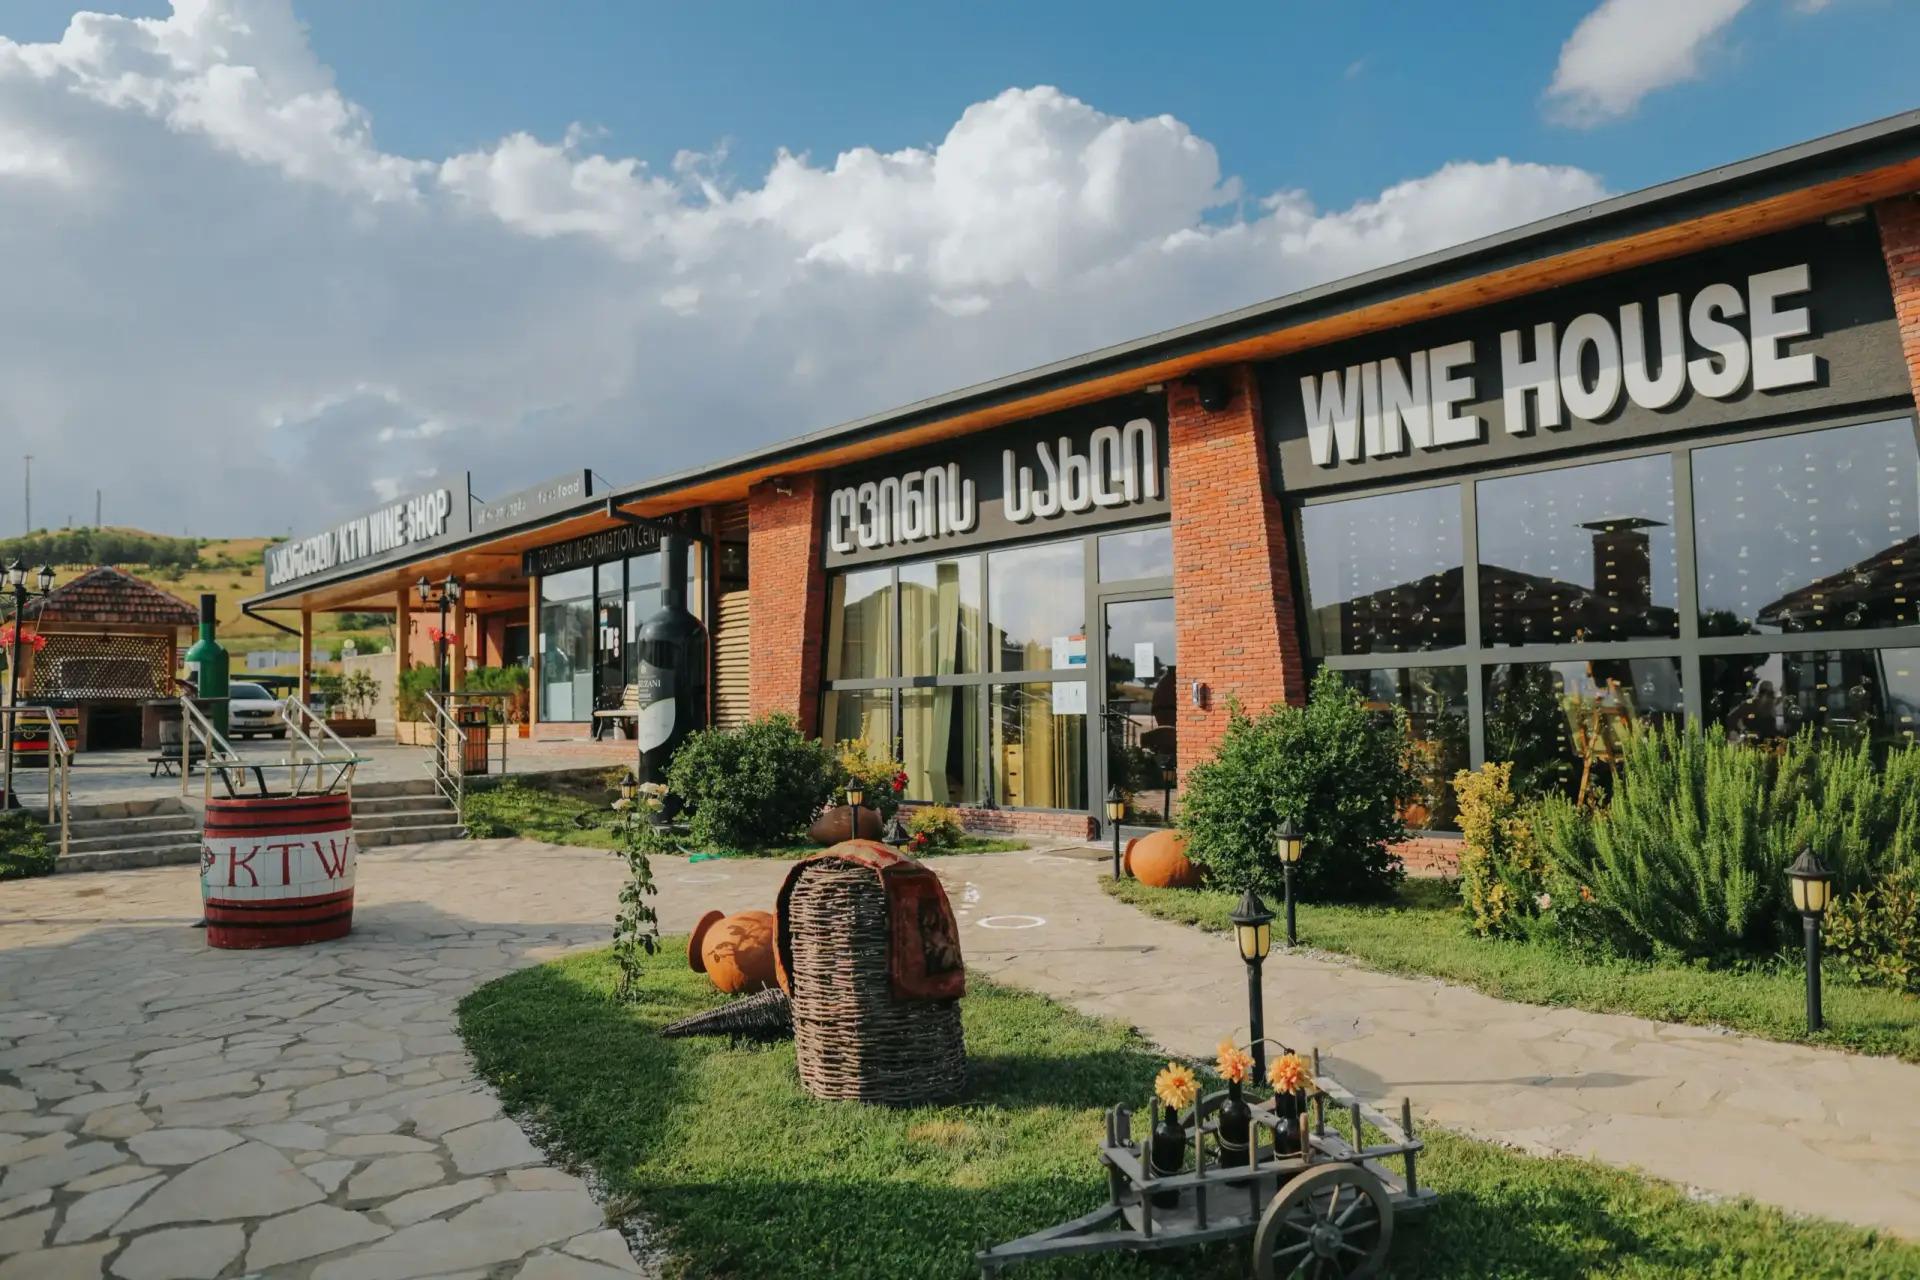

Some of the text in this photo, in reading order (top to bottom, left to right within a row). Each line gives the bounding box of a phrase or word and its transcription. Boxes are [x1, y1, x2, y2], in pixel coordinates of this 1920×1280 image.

[1301, 263, 1817, 466] WINE HOUSE
[558, 478, 580, 498] food
[830, 418, 1159, 552] ღვინის სახლი
[340, 516, 368, 563] KTW
[369, 504, 404, 554] WINE
[407, 488, 448, 542] SHOP
[540, 543, 573, 569] TOURISM
[573, 527, 635, 562] INFORMATION
[228, 837, 350, 888] KTW
